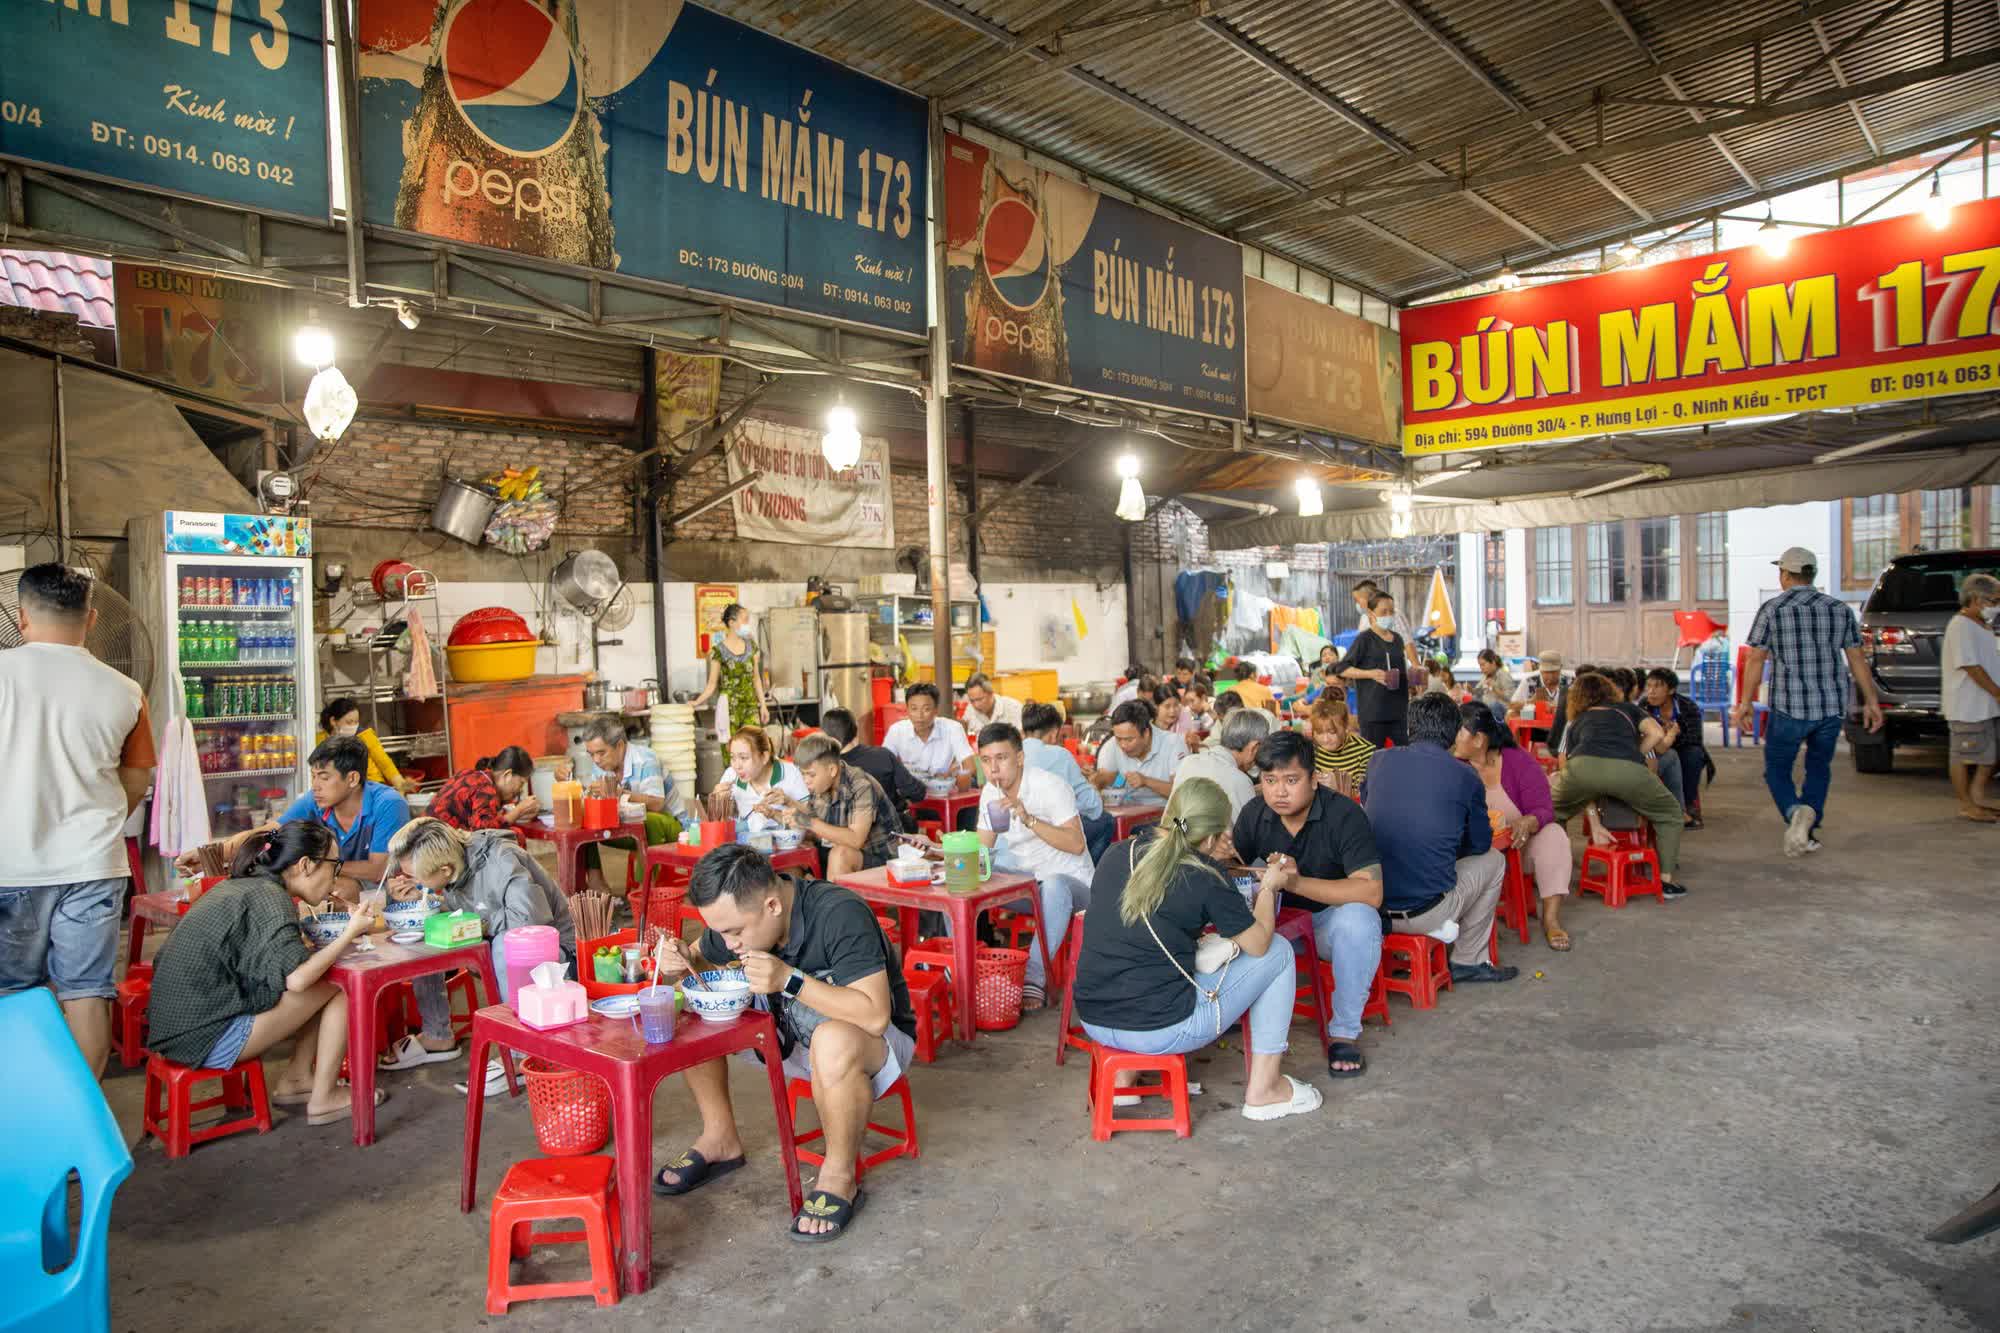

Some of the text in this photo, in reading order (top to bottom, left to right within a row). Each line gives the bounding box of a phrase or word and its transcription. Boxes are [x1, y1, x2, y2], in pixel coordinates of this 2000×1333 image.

[234, 110, 276, 135] mời
[91, 121, 294, 186] ĐT: 0914. 063 042
[667, 68, 912, 239] BÚN MẮM 173
[443, 161, 578, 220] pepsi
[680, 249, 804, 289] ĐC: 173 ĐƯỜNG 30/4
[823, 283, 912, 314] ĐT: 0914. 063 042
[1094, 238, 1236, 350] BÚN MẮM 173
[985, 316, 1051, 355] pepsi
[1411, 316, 1573, 412] BÚN
[1600, 260, 1839, 389] MẮM
[1870, 376, 1897, 393] ĐT:
[1903, 370, 1948, 389] 0914
[1955, 364, 1991, 383] 063
[1415, 433, 1435, 449] Địa
[1465, 427, 1489, 441] 594
[1537, 418, 1566, 433] 30/4
[1580, 414, 1592, 429] P.
[1635, 406, 1657, 424] Lợi
[1673, 402, 1688, 418] Q.
[1692, 399, 1728, 415] Ninh
[1733, 391, 1769, 410] Kiều
[1786, 384, 1827, 403] TPCT
[180, 519, 218, 528] Panasonic
